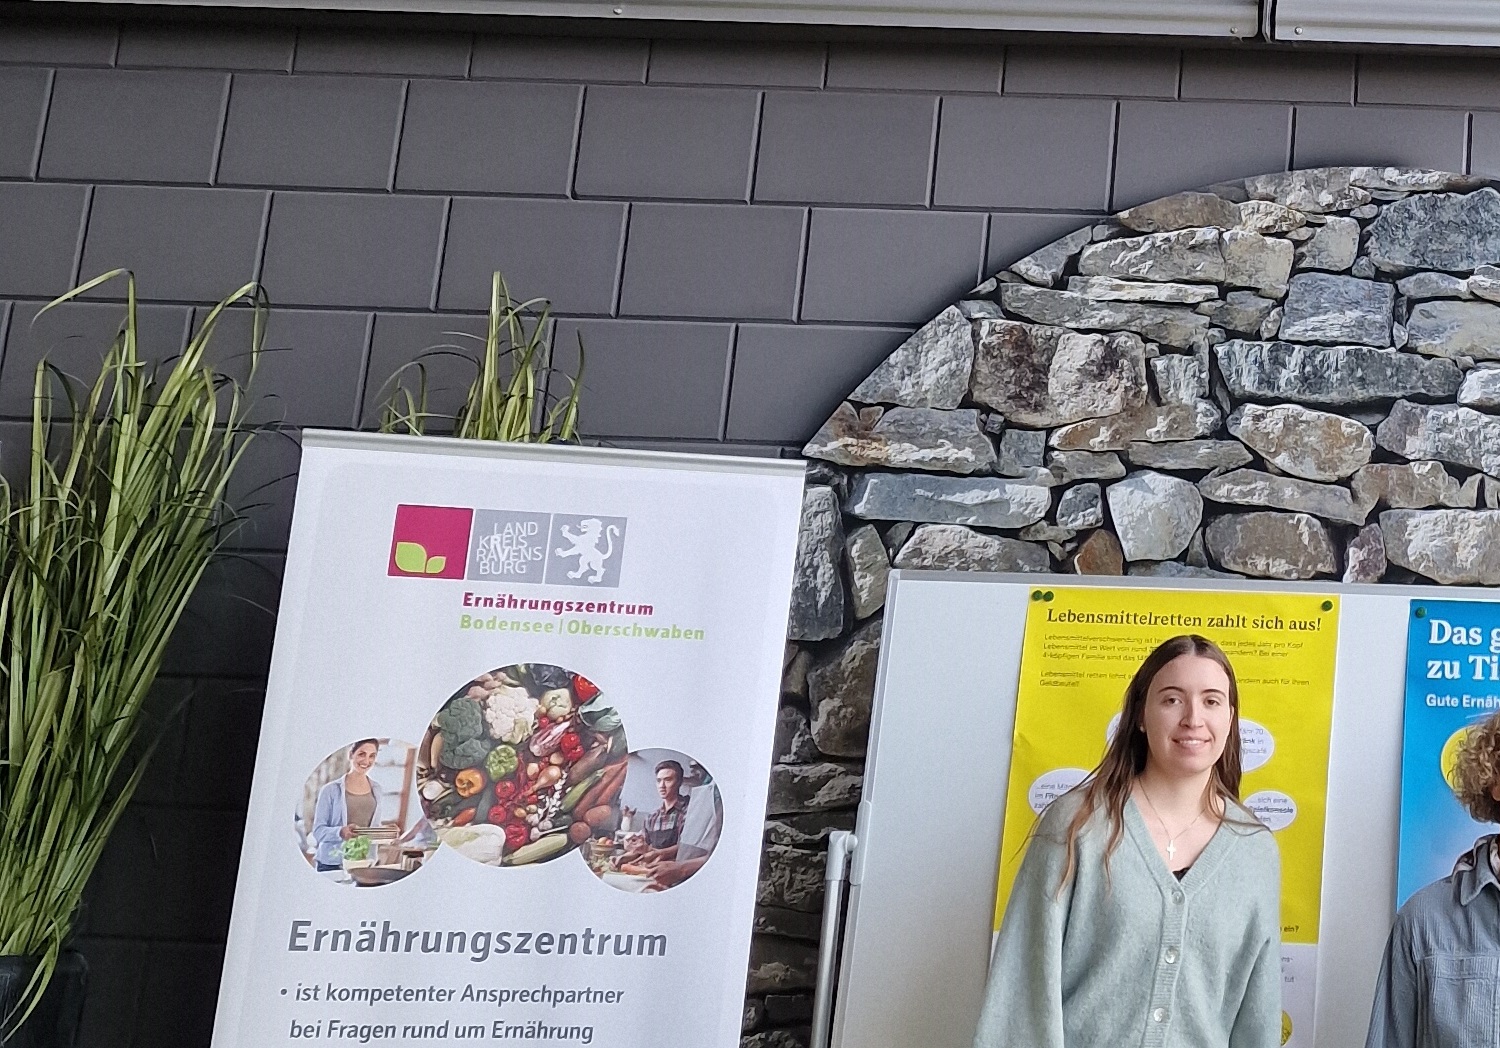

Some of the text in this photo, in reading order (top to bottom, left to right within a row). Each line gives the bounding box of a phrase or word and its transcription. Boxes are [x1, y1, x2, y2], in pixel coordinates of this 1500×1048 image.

[494, 522, 539, 536] LAND
[479, 534, 527, 549] KREIS
[476, 547, 543, 561] RAVENS
[479, 560, 527, 575] BURG
[463, 591, 654, 616] Ernährungszentrum
[1047, 608, 1321, 631] Lebensmittelretten zahlt sich aus!
[1428, 618, 1482, 646] Das
[1426, 658, 1461, 680] zu
[1426, 693, 1459, 708] Gute
[288, 919, 668, 963] Ernährungszentrum
[295, 983, 625, 1009] ist kompetenter Ansprechpartner
[289, 1020, 595, 1045] bei Fragen rund um Ernährung
